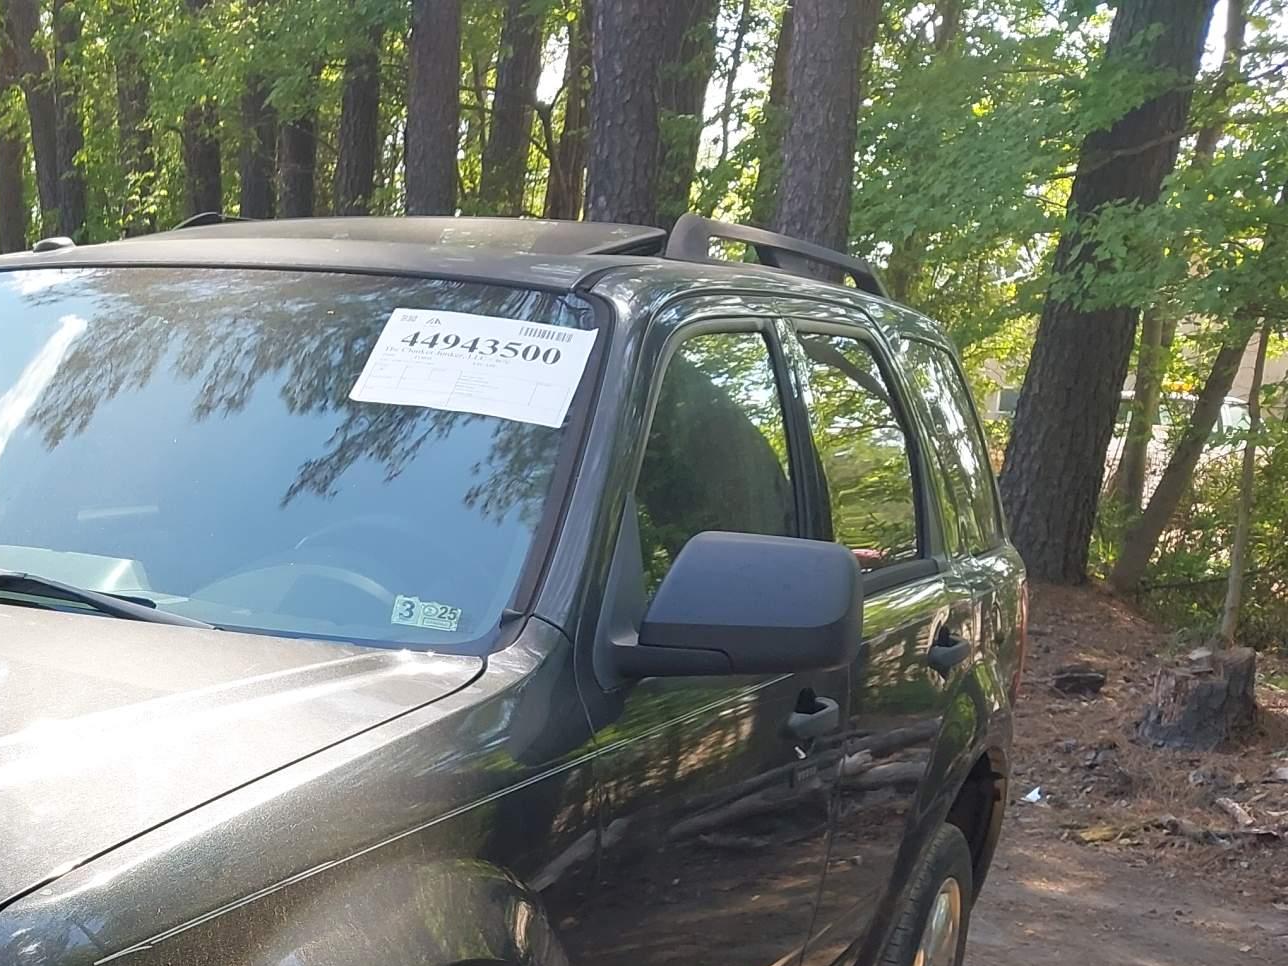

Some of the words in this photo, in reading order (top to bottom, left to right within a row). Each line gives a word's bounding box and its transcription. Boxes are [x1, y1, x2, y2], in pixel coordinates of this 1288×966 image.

[400, 331, 561, 366] 44943500
[399, 600, 415, 618] 3
[438, 606, 458, 620] 25
